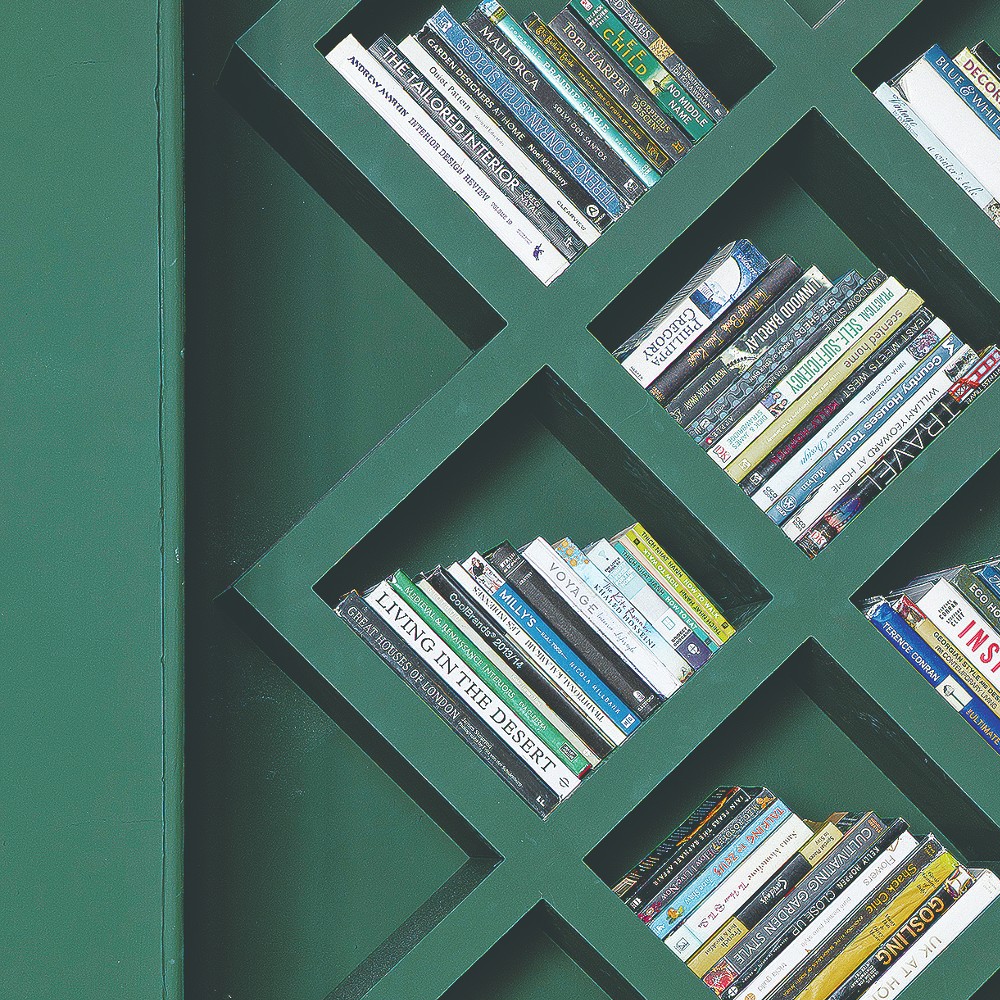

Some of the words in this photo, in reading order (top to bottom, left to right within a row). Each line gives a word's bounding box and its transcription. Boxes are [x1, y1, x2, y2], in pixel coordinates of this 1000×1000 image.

[621, 6, 652, 39] JAMES
[478, 24, 540, 91] MALLORCA
[602, 27, 648, 76] CHILD
[616, 29, 647, 61] LEE
[426, 38, 457, 70] GARDEN
[455, 68, 494, 109] DESIGNERS
[491, 107, 505, 120] AT
[500, 116, 525, 142] HOME
[427, 65, 449, 88] Quiet
[446, 85, 472, 111] Pattern
[934, 55, 965, 87] BLUE
[958, 83, 976, 99] &
[379, 46, 410, 76] THE
[405, 71, 466, 136] TAILORED
[461, 130, 521, 192] INTERIOR
[666, 83, 681, 99] NO
[678, 95, 708, 128] MIDDLE
[667, 99, 692, 125] NAME
[407, 117, 441, 151] INTERIOR
[437, 148, 465, 175] DESIGN
[462, 173, 491, 202] REVIEW
[778, 276, 820, 318] LINWOOD
[818, 296, 837, 315] SHE
[845, 274, 881, 310] WINDOW
[641, 306, 696, 361] GREGORY
[743, 312, 784, 353] BARCLAY
[793, 313, 820, 339] SHEDS
[821, 306, 848, 332] STYLE
[867, 308, 904, 345] scented
[650, 317, 703, 367] PHILIPPA
[842, 341, 871, 369] home
[899, 351, 942, 394] Country
[862, 391, 904, 432] Houses
[904, 386, 940, 421] WILLIAM
[726, 408, 763, 445] STRAWBRIDGE
[866, 417, 908, 459] YEOWARD
[831, 429, 866, 462] Today
[855, 455, 868, 471] AT
[857, 399, 961, 495] TRAVEL
[830, 467, 857, 494] HOME
[548, 561, 599, 615] VOYAGE
[682, 578, 697, 592] HOW
[693, 589, 705, 603] TO
[703, 600, 720, 619] WALK
[968, 582, 989, 604] ECO
[498, 589, 537, 628] MILLY'S
[664, 595, 679, 609] HOW
[675, 606, 688, 620] TO
[684, 616, 698, 630] EAT
[938, 600, 958, 620] CONRAN
[346, 606, 379, 638] GREAT
[374, 633, 412, 672] HOUSES
[408, 668, 425, 684] OF
[421, 681, 460, 720] LONDON
[881, 621, 913, 654] TERENCE
[910, 651, 940, 682] CONRAN
[375, 591, 437, 654] LIVING
[433, 650, 460, 676] IN
[454, 672, 492, 710] THE
[489, 707, 556, 773] DESERT
[569, 661, 592, 685] NICOLA
[591, 684, 621, 714] MILLBANK
[807, 847, 822, 861] Places
[819, 834, 835, 850] Special
[860, 845, 880, 866] KELLY
[836, 863, 862, 890] HOPPEN
[862, 854, 896, 887] Flowers
[886, 863, 917, 894] Shack
[801, 887, 837, 923] CLOSE
[864, 890, 889, 915] Chic
[719, 925, 742, 948] French
[787, 917, 807, 937] UP
[873, 894, 946, 967] GOSLING
[920, 935, 942, 958] UK
[756, 974, 773, 993] guild
[770, 961, 788, 978] tricia
[899, 956, 919, 979] AT
